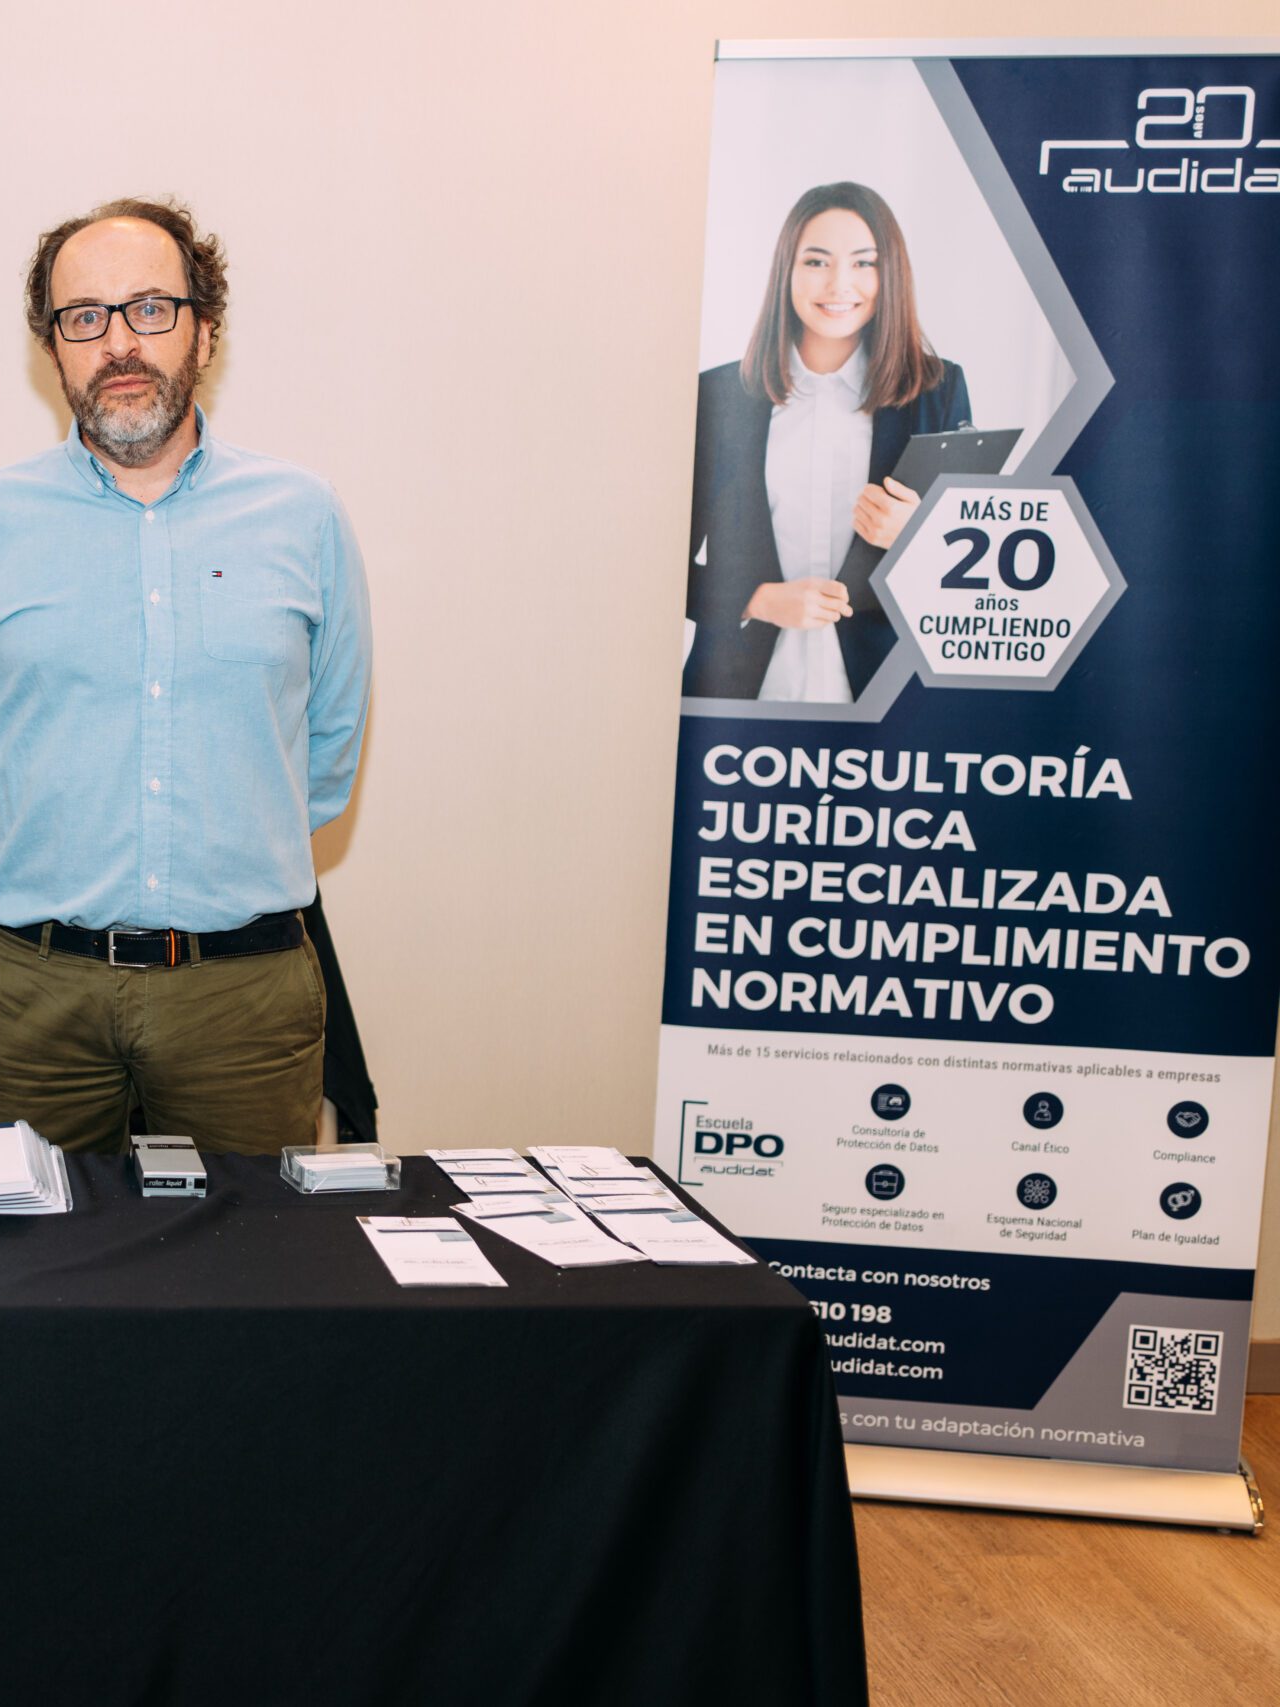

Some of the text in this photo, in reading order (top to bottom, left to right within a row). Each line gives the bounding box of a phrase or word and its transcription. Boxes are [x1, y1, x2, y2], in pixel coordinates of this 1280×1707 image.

[1135, 86, 1256, 148] 20
[1193, 105, 1205, 139] AÑOS
[1062, 158, 1280, 193] audida
[961, 496, 1048, 521] MÁS DE
[941, 528, 1055, 591] 20
[975, 594, 1018, 611] años
[920, 616, 1070, 642] CUMPLIENDO
[942, 640, 1045, 661] CONTIGO
[703, 745, 1132, 803] CONSULTORÍA
[698, 794, 976, 851] JURÍDICA
[697, 857, 1172, 920] ESPECIALIZADA
[695, 912, 1250, 981] EN CUMPLIMIENTO
[692, 965, 1058, 1024] NORMATIVO
[708, 1044, 1220, 1083] Más de 15 servicios relacionados con distintas normativas aplicables a empresas
[696, 1115, 753, 1130] Escuela
[852, 1125, 925, 1138] Consultoría de
[694, 1131, 784, 1158] DPO
[837, 1137, 939, 1153] Protección de Datos
[1012, 1141, 1069, 1154] Canal Ético
[1153, 1150, 1215, 1163] Compliance
[700, 1164, 776, 1176] audidat
[822, 1203, 857, 1220] Seguro
[858, 1208, 929, 1223] especializado
[822, 1216, 923, 1232] Protección de Datos
[987, 1214, 1082, 1230] Esquema Nacional
[1000, 1228, 1067, 1241] de Seguridad
[1132, 1230, 1219, 1245] Plan de Igualdad
[769, 1261, 990, 1290] Contacta con nosotros
[851, 1304, 891, 1323] 198
[830, 1358, 943, 1379] udidat.com
[852, 1414, 889, 1428] con
[896, 1415, 916, 1430] tu
[921, 1415, 1034, 1439] adaptación
[1041, 1429, 1144, 1447] normativa
